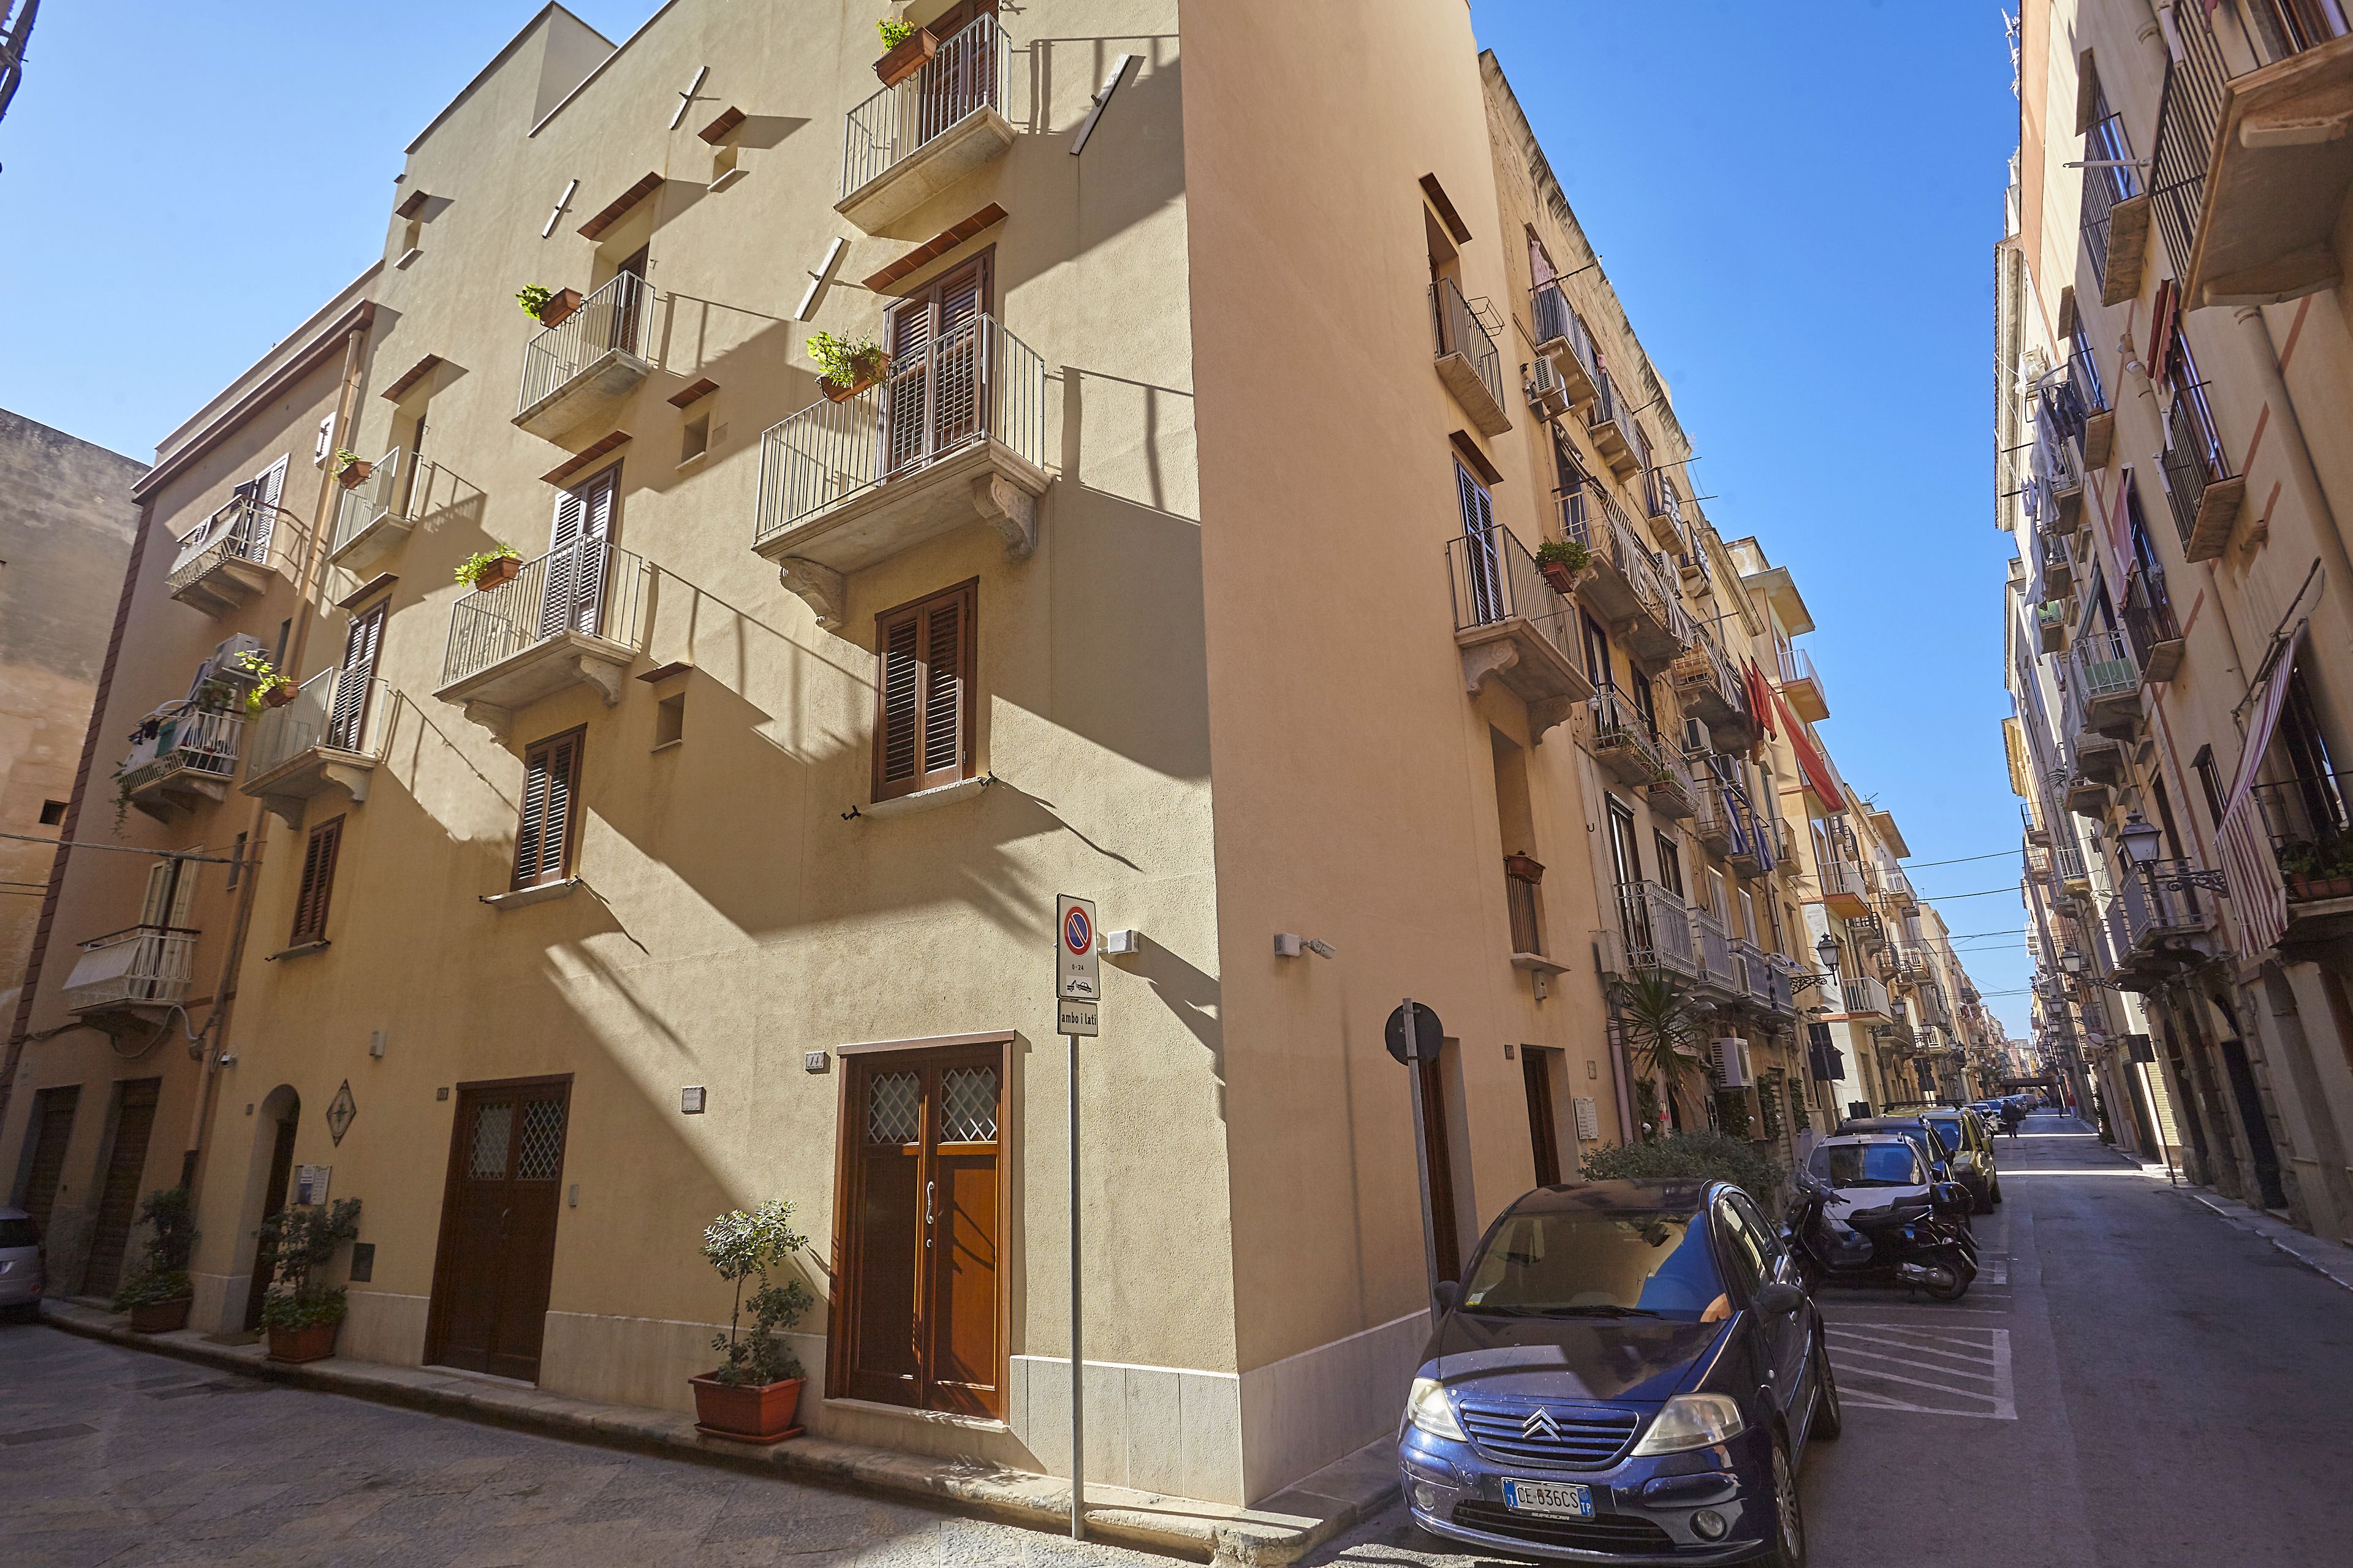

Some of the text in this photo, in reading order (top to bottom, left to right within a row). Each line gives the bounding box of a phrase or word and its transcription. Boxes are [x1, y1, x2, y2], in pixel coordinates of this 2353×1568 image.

[1061, 1012, 1078, 1024] ambo
[1085, 1013, 1097, 1026] lati
[810, 1056, 819, 1066] 14
[1581, 1502, 1591, 1513] TP
